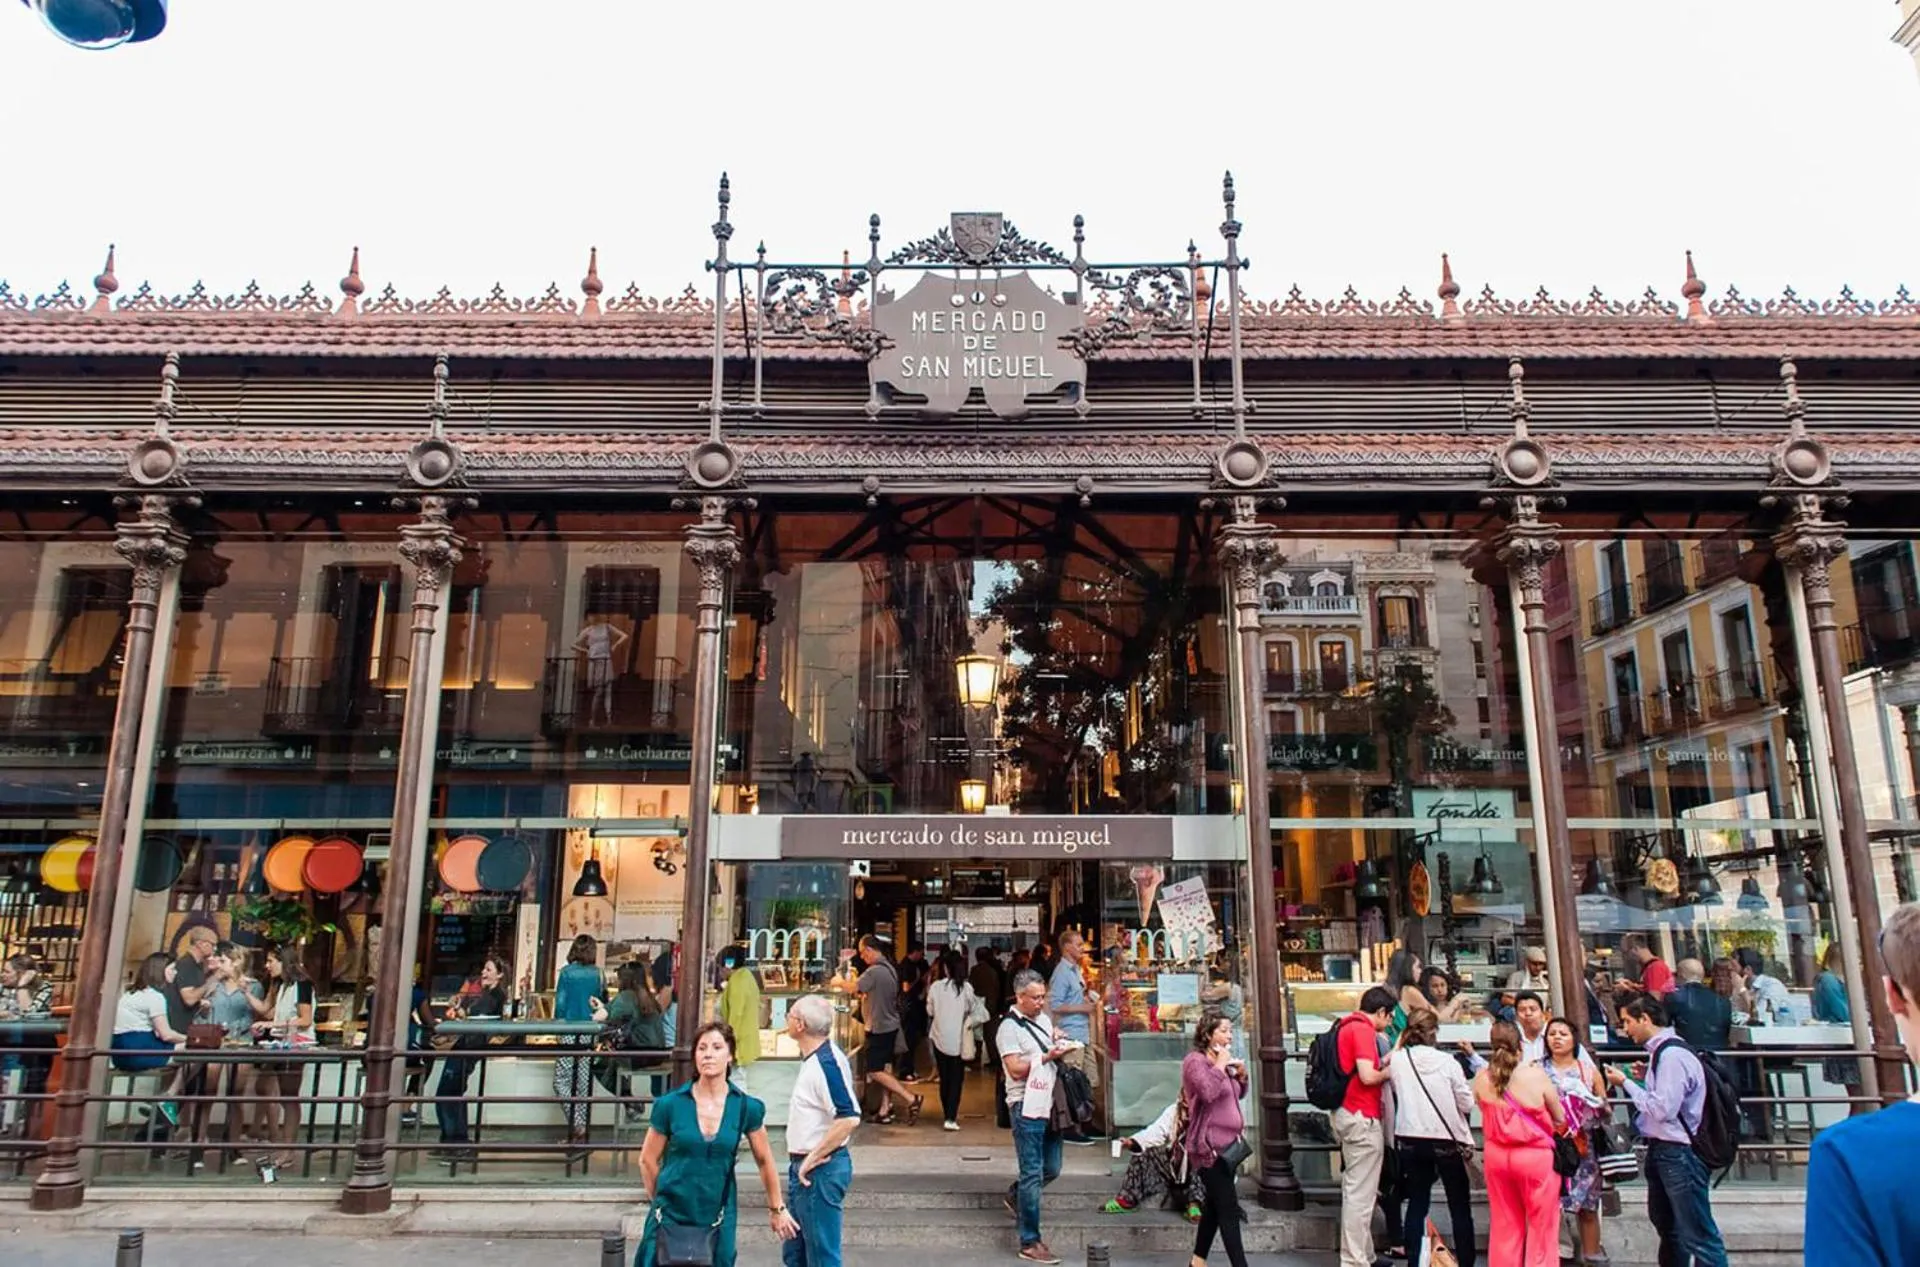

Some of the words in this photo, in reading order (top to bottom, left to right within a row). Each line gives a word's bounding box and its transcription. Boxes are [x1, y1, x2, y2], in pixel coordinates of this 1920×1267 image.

[911, 310, 1046, 332] MERCADO
[963, 335, 997, 350] DE
[901, 355, 950, 378] SAN
[962, 353, 1054, 378] MIGUEL
[841, 823, 944, 846] mercado
[949, 823, 979, 846] de
[984, 828, 1027, 846] san
[1031, 824, 1112, 853] miguel
